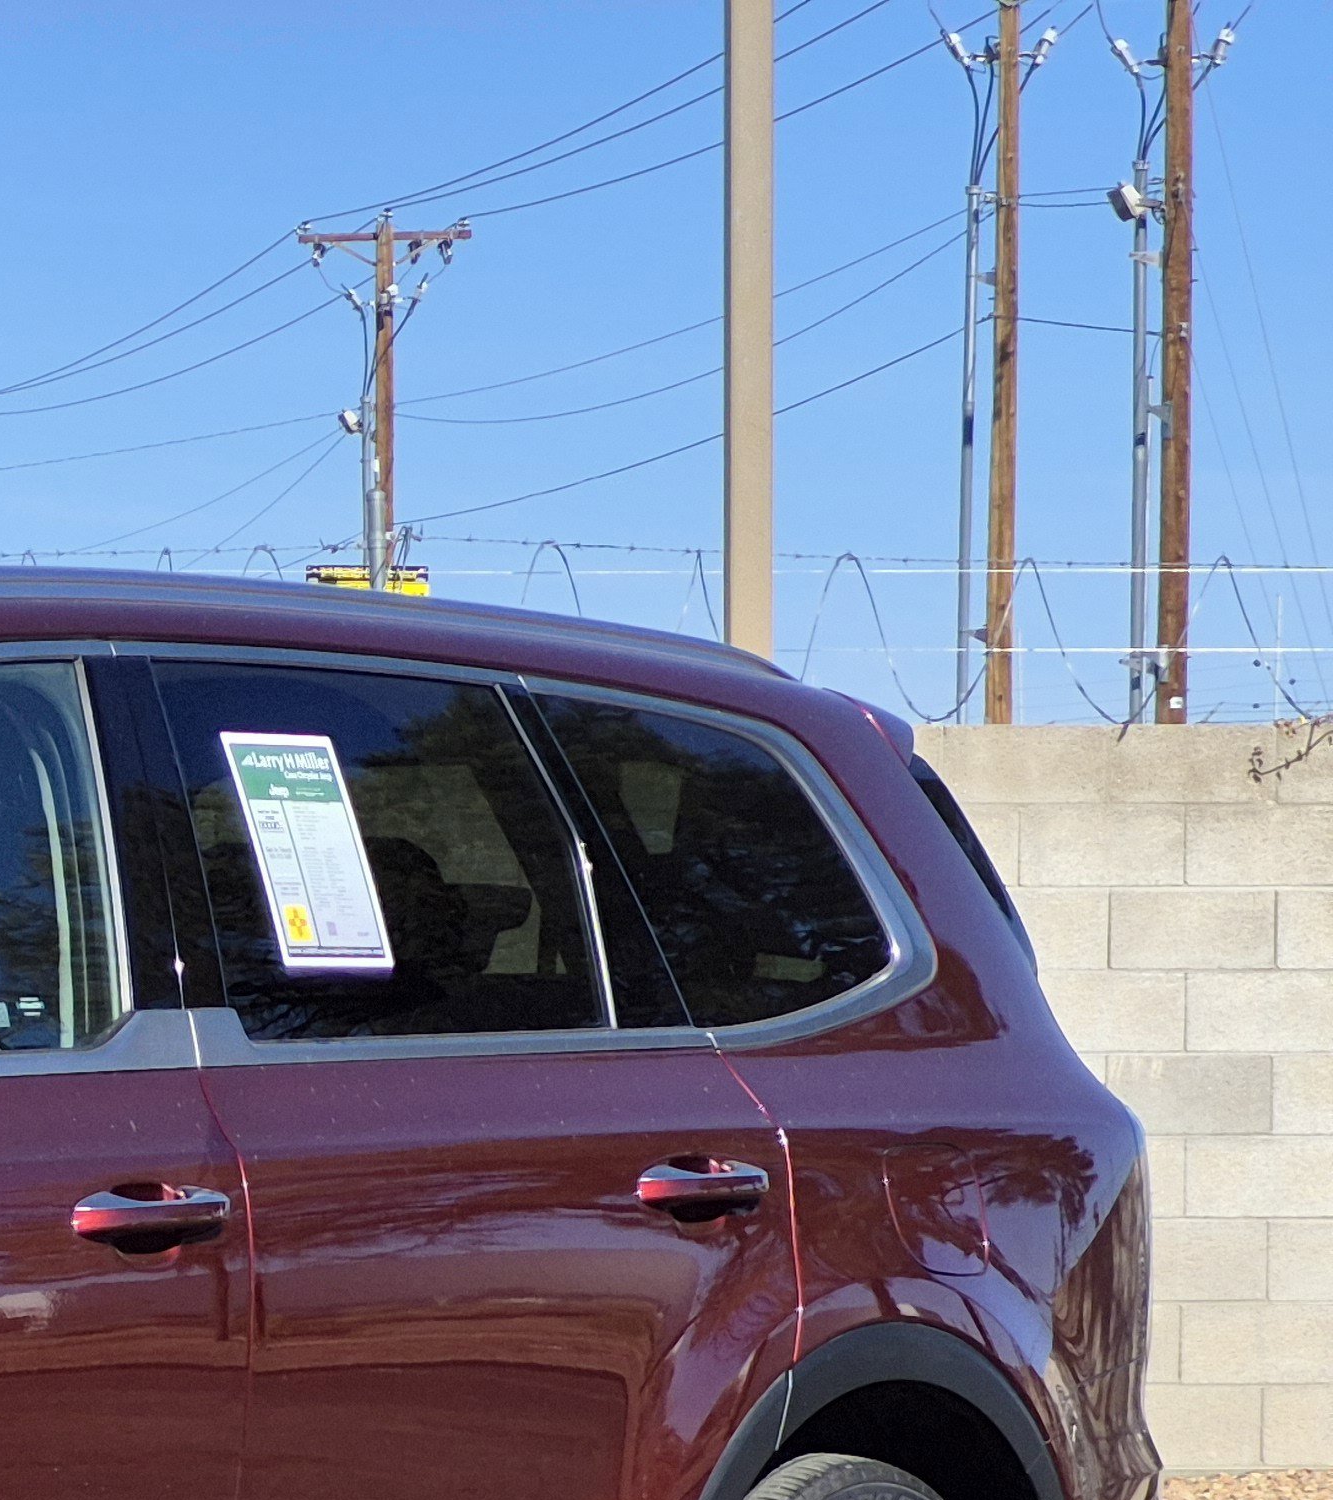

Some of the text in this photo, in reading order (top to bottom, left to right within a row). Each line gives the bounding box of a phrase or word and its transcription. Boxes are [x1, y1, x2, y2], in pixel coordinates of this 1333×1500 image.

[251, 751, 329, 772] Larry H Miller
